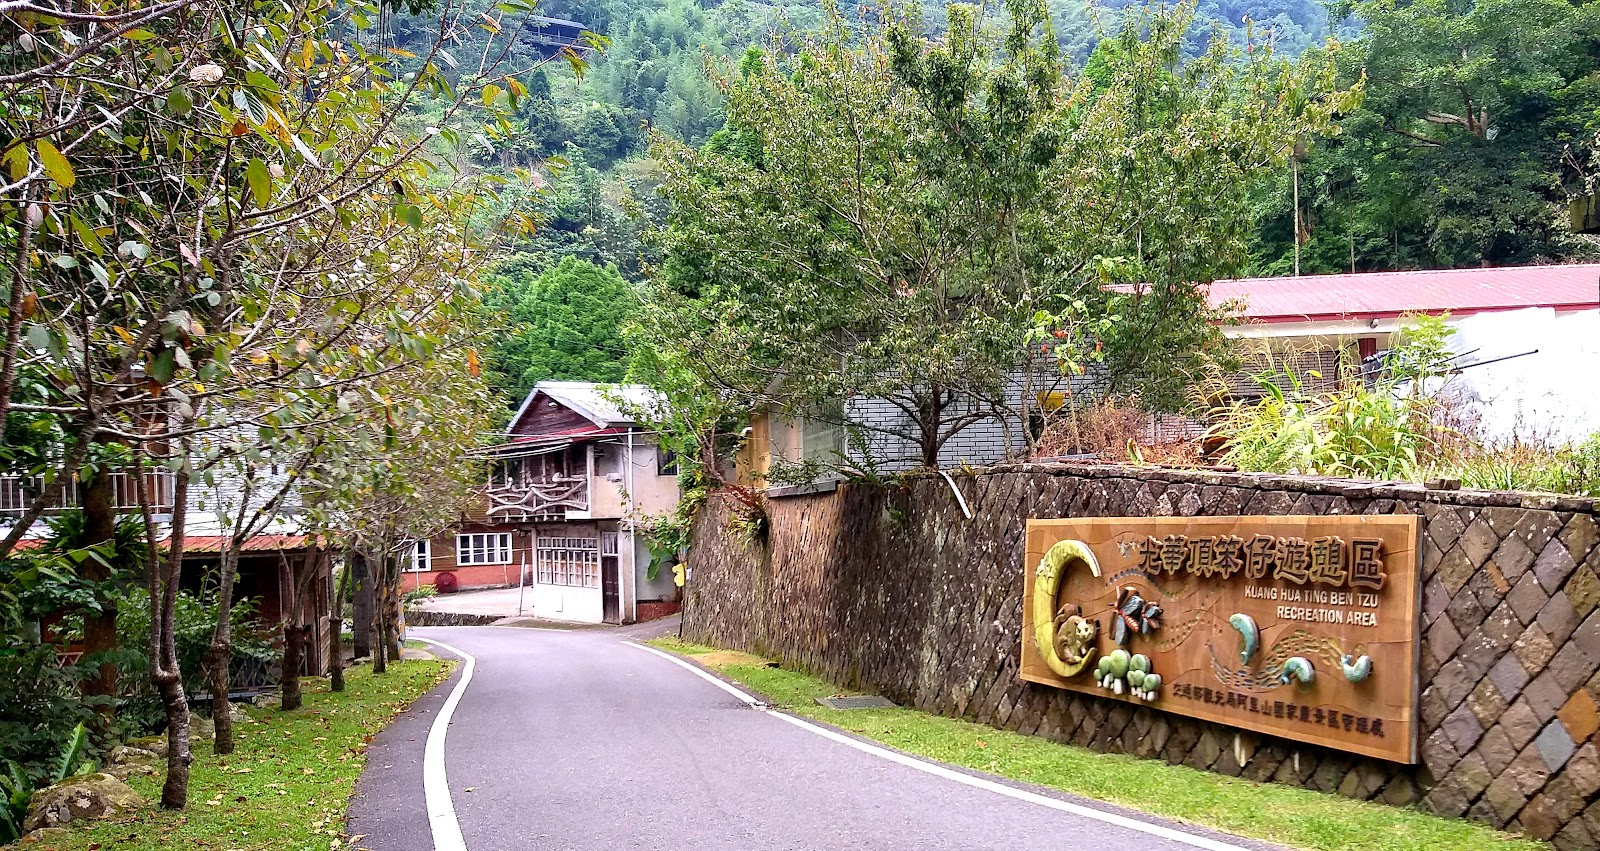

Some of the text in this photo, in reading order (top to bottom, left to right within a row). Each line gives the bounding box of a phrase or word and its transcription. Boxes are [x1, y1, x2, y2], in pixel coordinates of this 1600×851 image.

[1138, 534, 1385, 590] 光華頂笨仔遊憩區
[1244, 585, 1379, 608] KUANG HUA TING BEN TZU
[1276, 605, 1379, 627] RECREATION AREA
